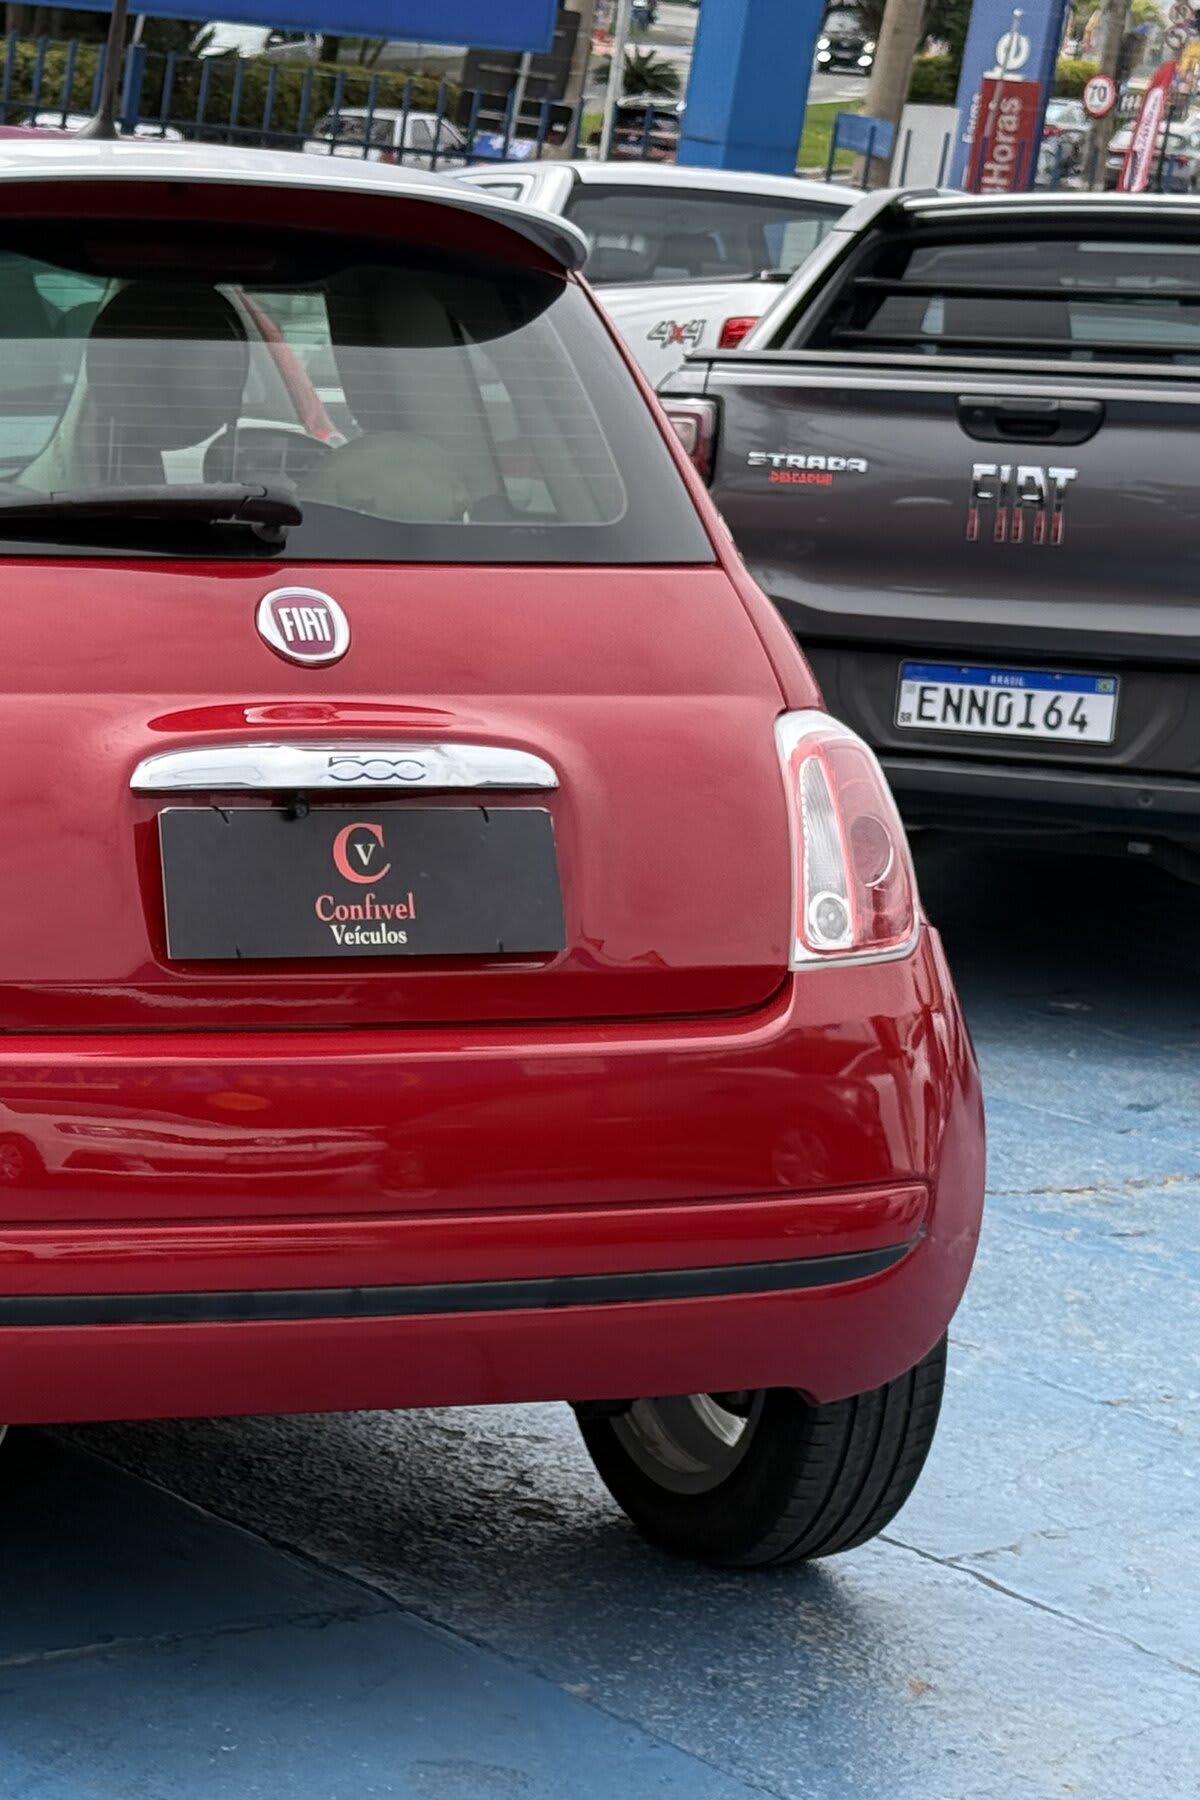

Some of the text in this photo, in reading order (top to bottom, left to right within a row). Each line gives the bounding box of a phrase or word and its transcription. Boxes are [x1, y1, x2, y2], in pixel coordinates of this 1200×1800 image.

[1089, 84, 1108, 103] 70
[981, 97, 1023, 187] Horas
[646, 318, 707, 349] 4x4
[747, 451, 869, 473] STRADA
[966, 463, 1079, 545] FIAT
[277, 606, 332, 642] FIAT
[327, 755, 427, 782] 500
[329, 922, 409, 946] Veículos
